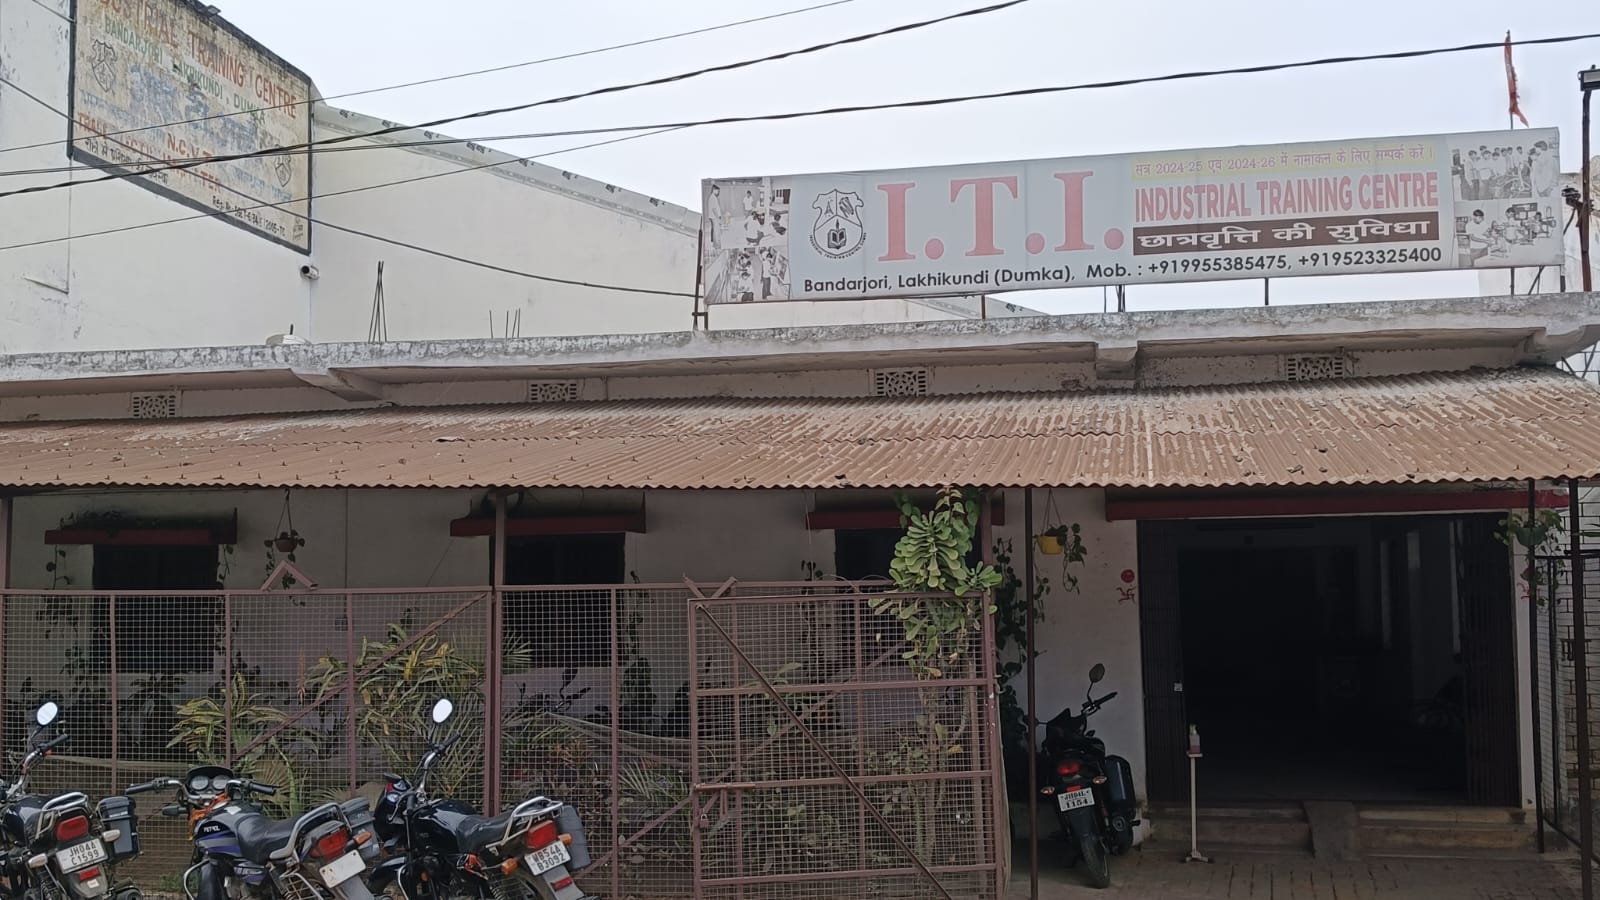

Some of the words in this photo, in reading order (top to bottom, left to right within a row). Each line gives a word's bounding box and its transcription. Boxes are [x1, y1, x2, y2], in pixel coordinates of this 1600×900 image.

[188, 29, 245, 88] TRAINING
[255, 75, 297, 120] CENTRE
[1156, 160, 1203, 174] 2024-25
[1227, 158, 1276, 170] 2024-26
[1280, 151, 1289, 166] में
[1336, 148, 1346, 163] के
[1352, 147, 1371, 163] लिए
[1376, 143, 1405, 161] सम्पर्क
[1136, 182, 1252, 223] INDUSTRIAL
[1256, 175, 1352, 216] TRAINING
[1359, 172, 1439, 210] CENTRE
[877, 171, 1125, 262] I.T.I.
[1137, 225, 1262, 249] छात्रवृत्ति
[1271, 222, 1316, 241] की
[1326, 218, 1431, 243] सुविधा
[804, 275, 893, 294] Bandarjori,
[898, 270, 990, 288] Lakhikundi
[994, 265, 1075, 287] (Dumka),
[1086, 263, 1132, 278] Mob.
[1148, 254, 1292, 275] +919955385475,
[1298, 247, 1442, 267] +919523325400
[69, 841, 97, 857] JH04A
[71, 849, 99, 866] C1599
[531, 844, 561, 863] WB54A
[536, 852, 566, 871] B3092
